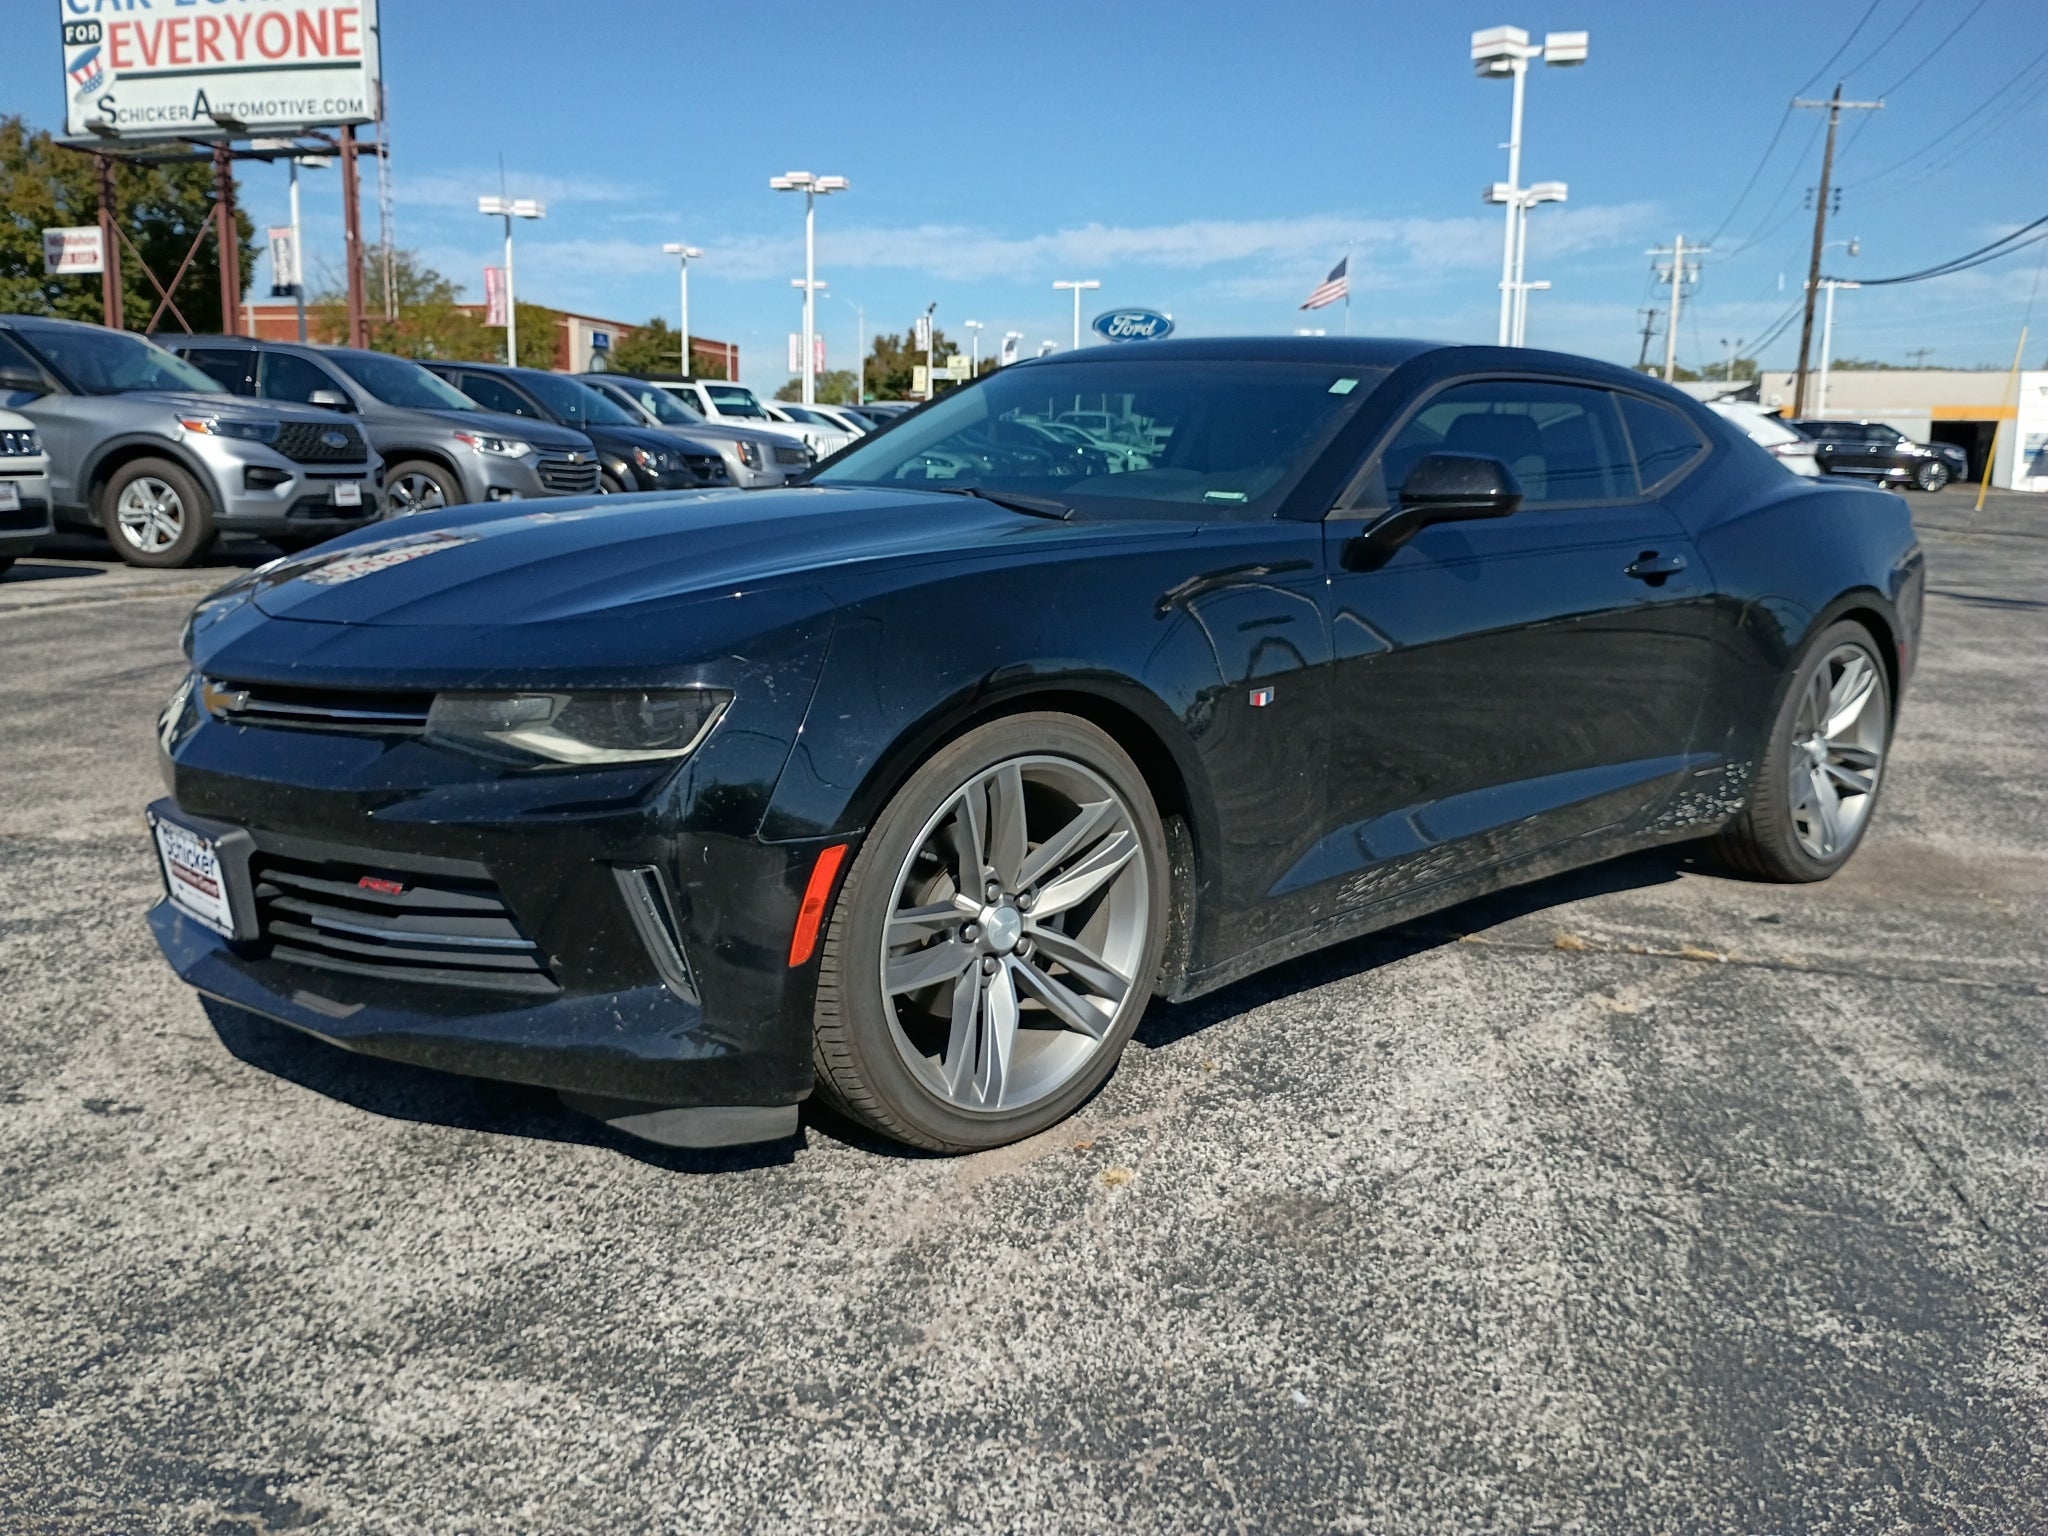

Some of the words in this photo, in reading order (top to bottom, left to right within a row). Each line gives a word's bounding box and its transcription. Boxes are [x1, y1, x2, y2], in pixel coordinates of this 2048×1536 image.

[65, 23, 100, 41] FOR
[109, 8, 361, 68] EVERYONE
[1108, 314, 1158, 336] Ford
